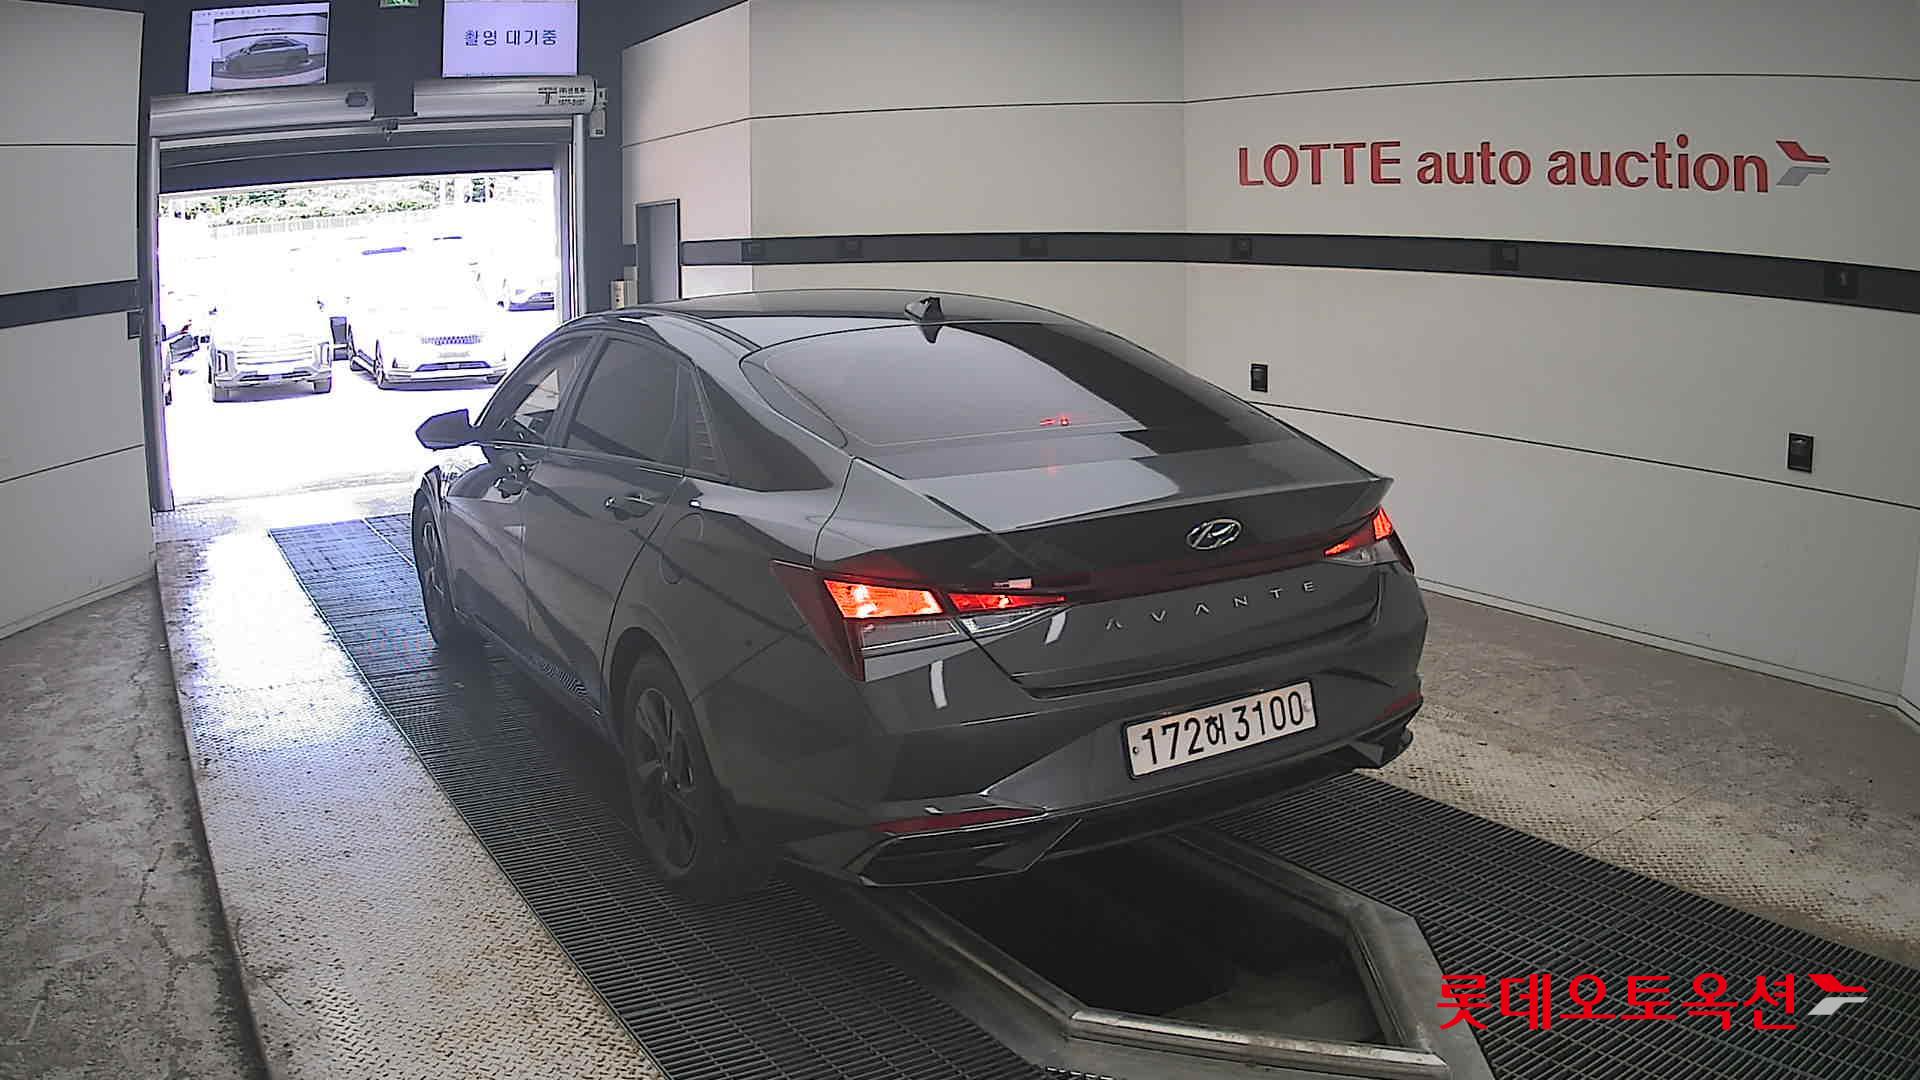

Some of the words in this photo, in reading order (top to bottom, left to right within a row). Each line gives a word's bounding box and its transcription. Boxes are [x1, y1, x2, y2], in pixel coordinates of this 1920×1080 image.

[506, 29, 557, 46] 대기중
[1238, 141, 1400, 187] LOTTE
[1416, 141, 1531, 185] auto
[1547, 134, 1769, 193] auction
[1105, 581, 1315, 631] AVANTE
